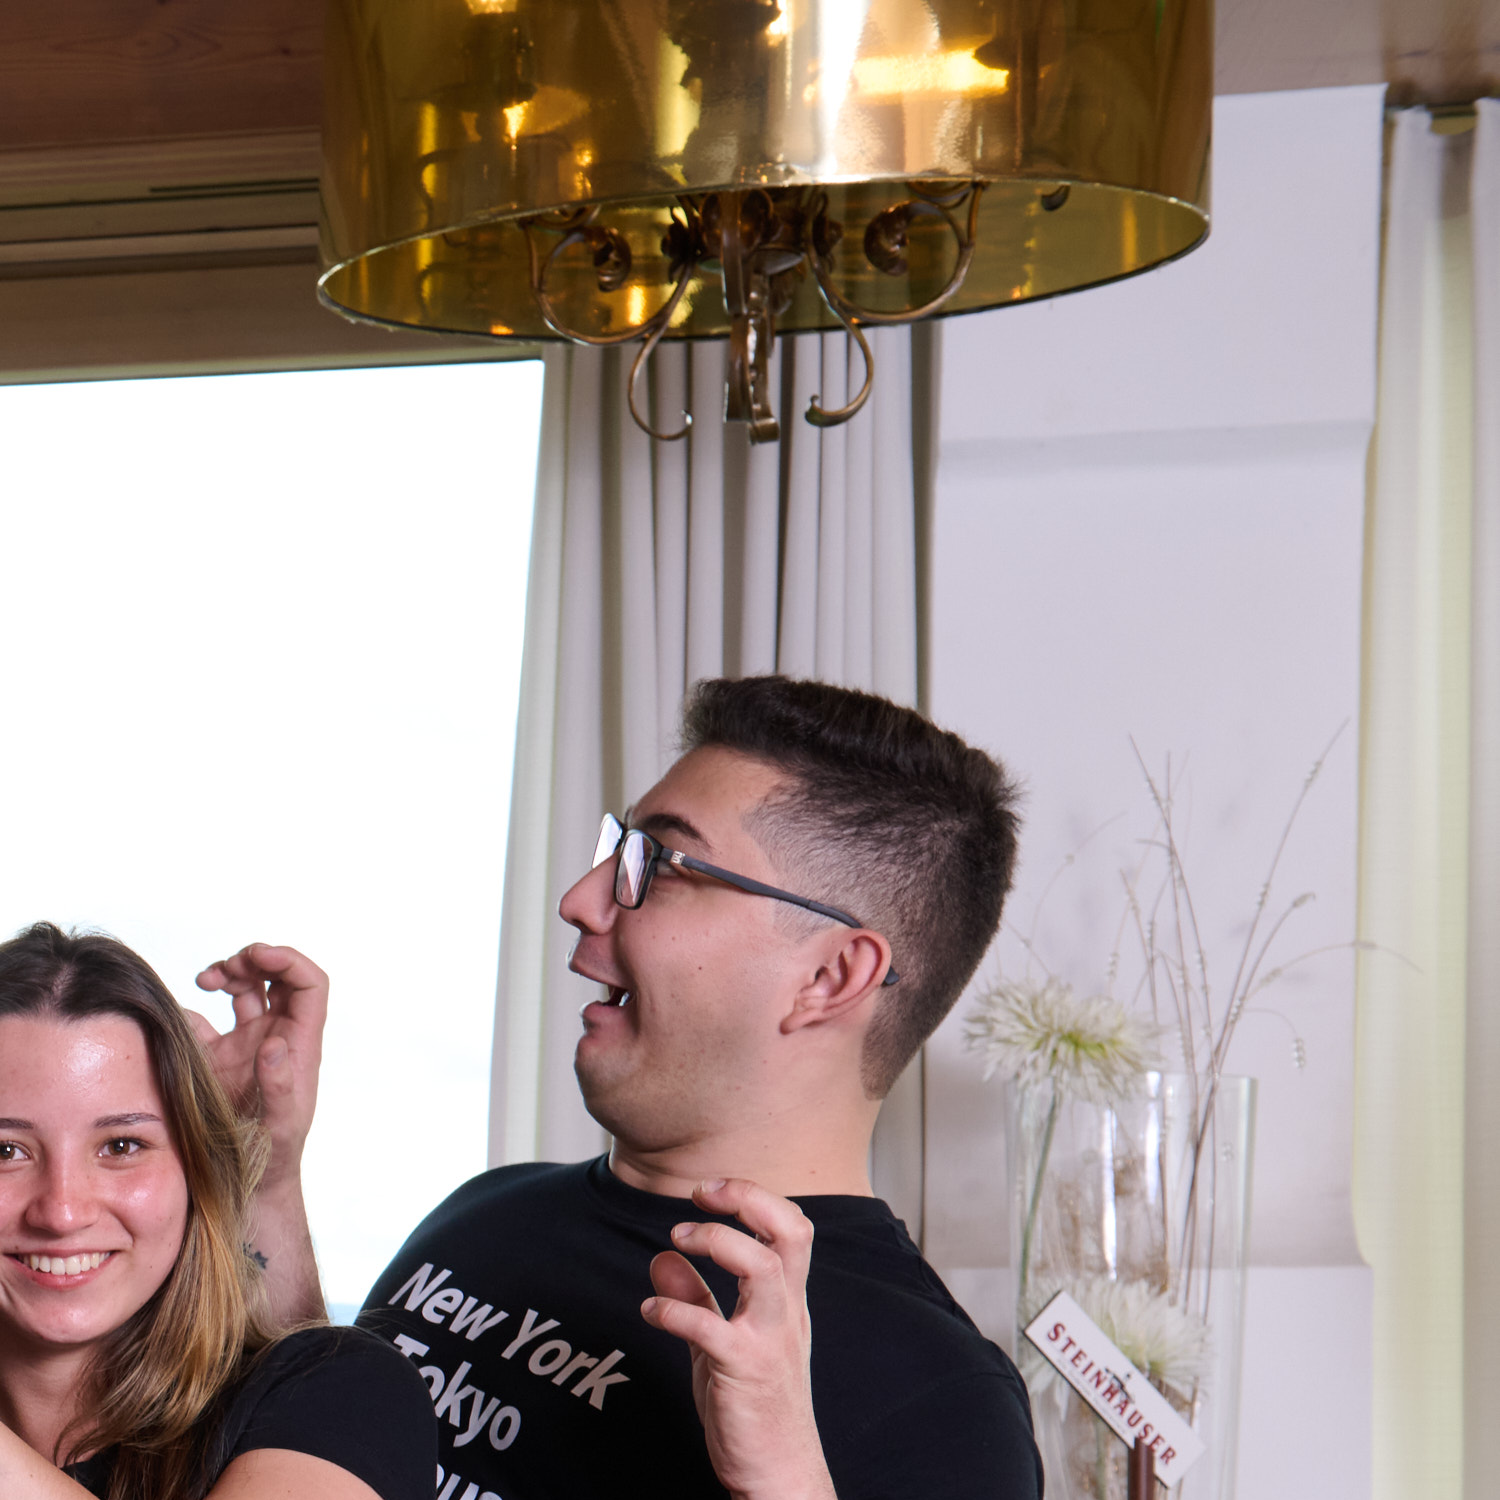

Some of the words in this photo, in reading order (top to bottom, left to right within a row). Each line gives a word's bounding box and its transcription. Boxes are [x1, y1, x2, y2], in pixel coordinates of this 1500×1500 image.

[388, 1262, 509, 1341] New
[501, 1308, 631, 1411] York
[1047, 1322, 1176, 1465] STEINHAUSER
